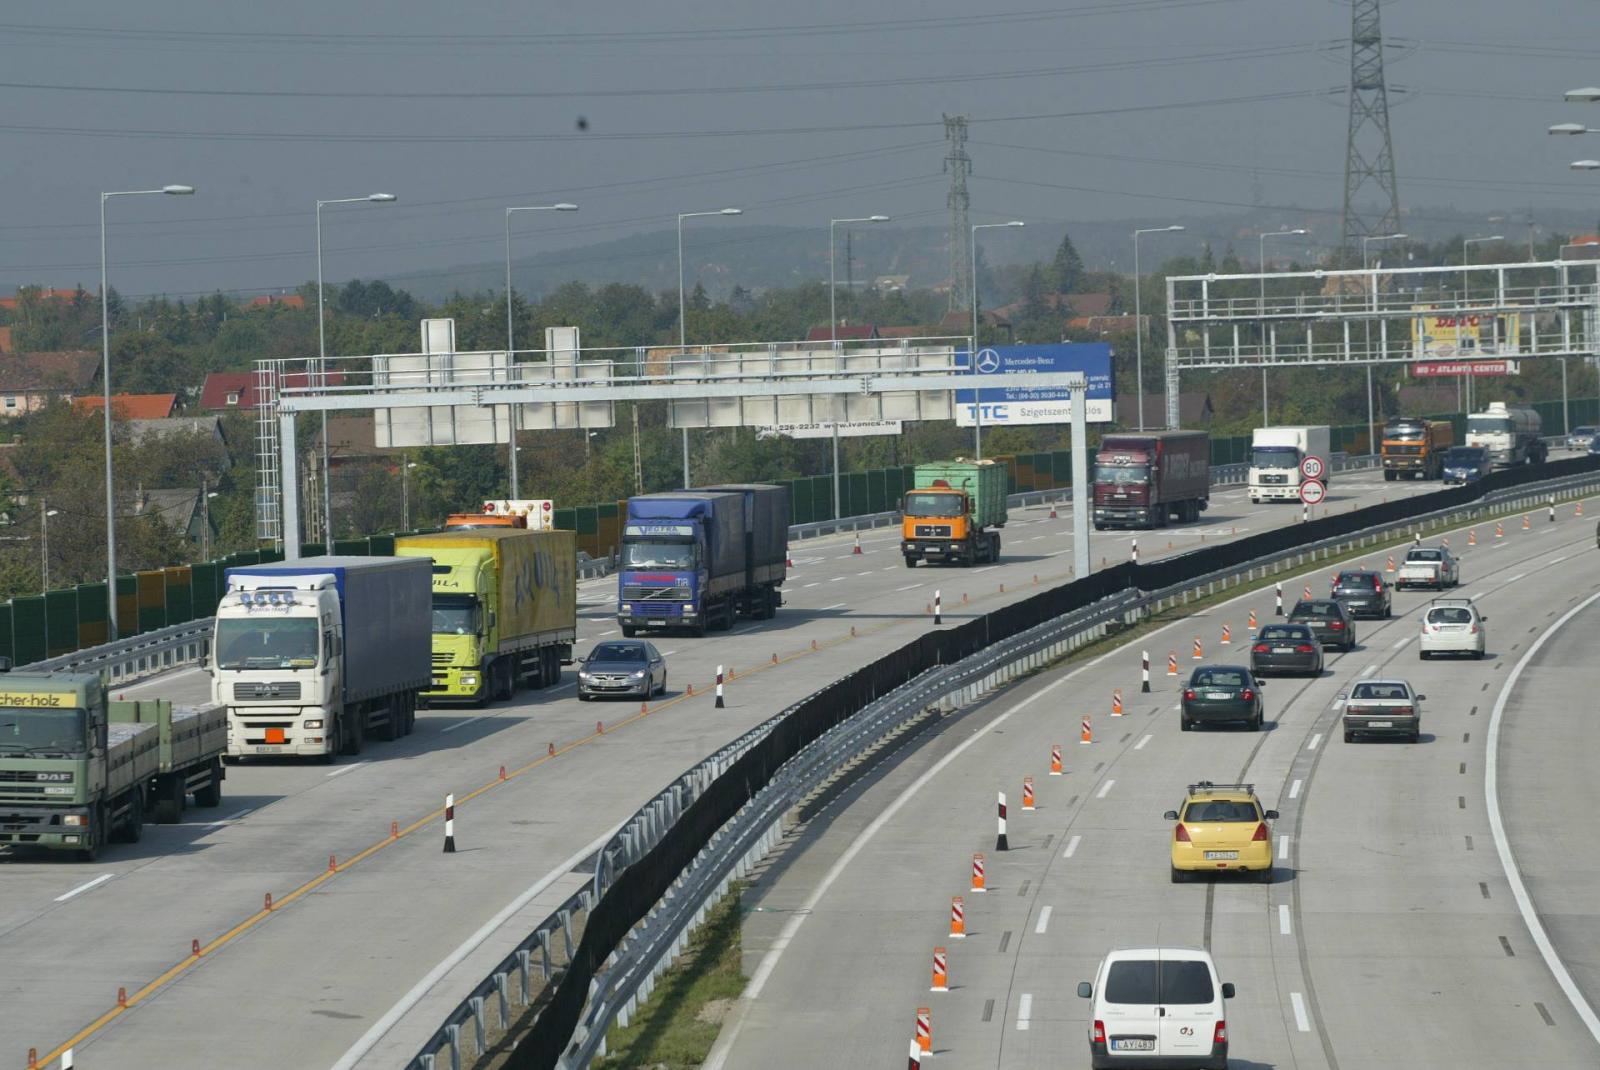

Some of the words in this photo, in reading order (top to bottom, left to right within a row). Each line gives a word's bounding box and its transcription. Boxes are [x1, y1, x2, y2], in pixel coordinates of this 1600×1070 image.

[1004, 357, 1055, 366] Mercedes-Benz
[1436, 365, 1472, 373] ATLANTA
[1473, 364, 1505, 373] CENTER
[967, 405, 1008, 420] TTC
[1020, 407, 1102, 418] Szigetszentlós
[1306, 462, 1318, 473] 80
[36, 773, 71, 781] DAF
